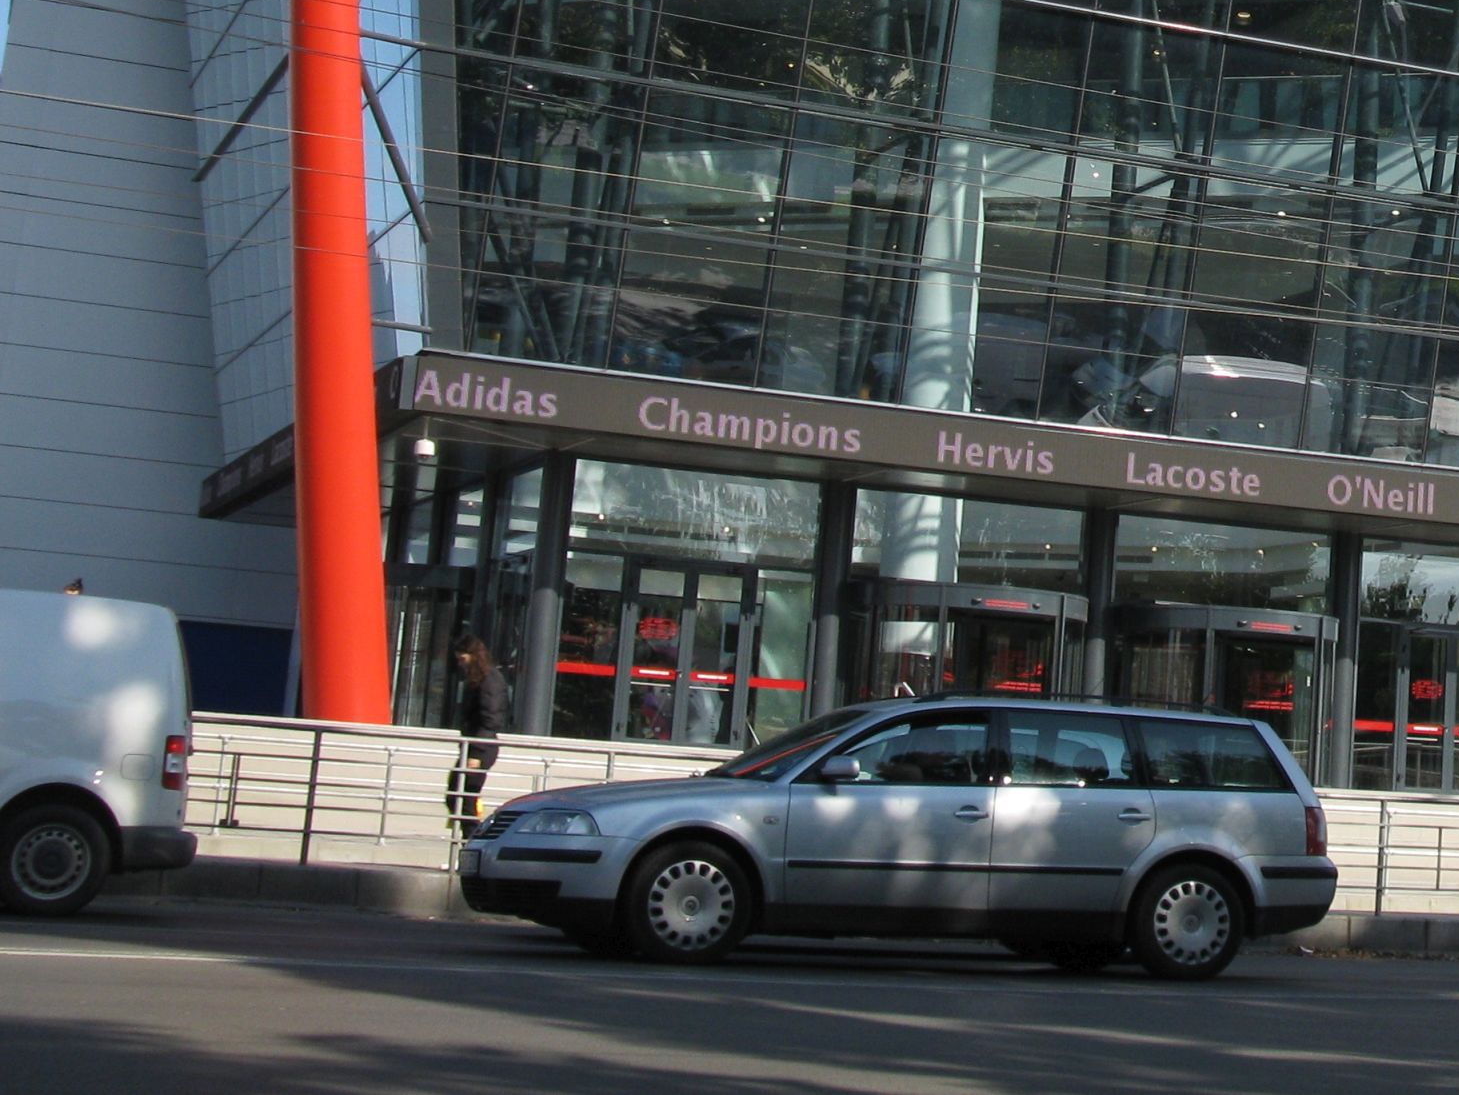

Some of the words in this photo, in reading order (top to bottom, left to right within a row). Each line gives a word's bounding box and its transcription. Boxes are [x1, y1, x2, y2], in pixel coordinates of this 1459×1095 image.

[414, 369, 559, 419] Adidas
[638, 395, 862, 450] Champions
[936, 430, 1055, 475] Hervis
[1125, 451, 1262, 497] Lacoste
[1326, 474, 1435, 515] O'Neill
